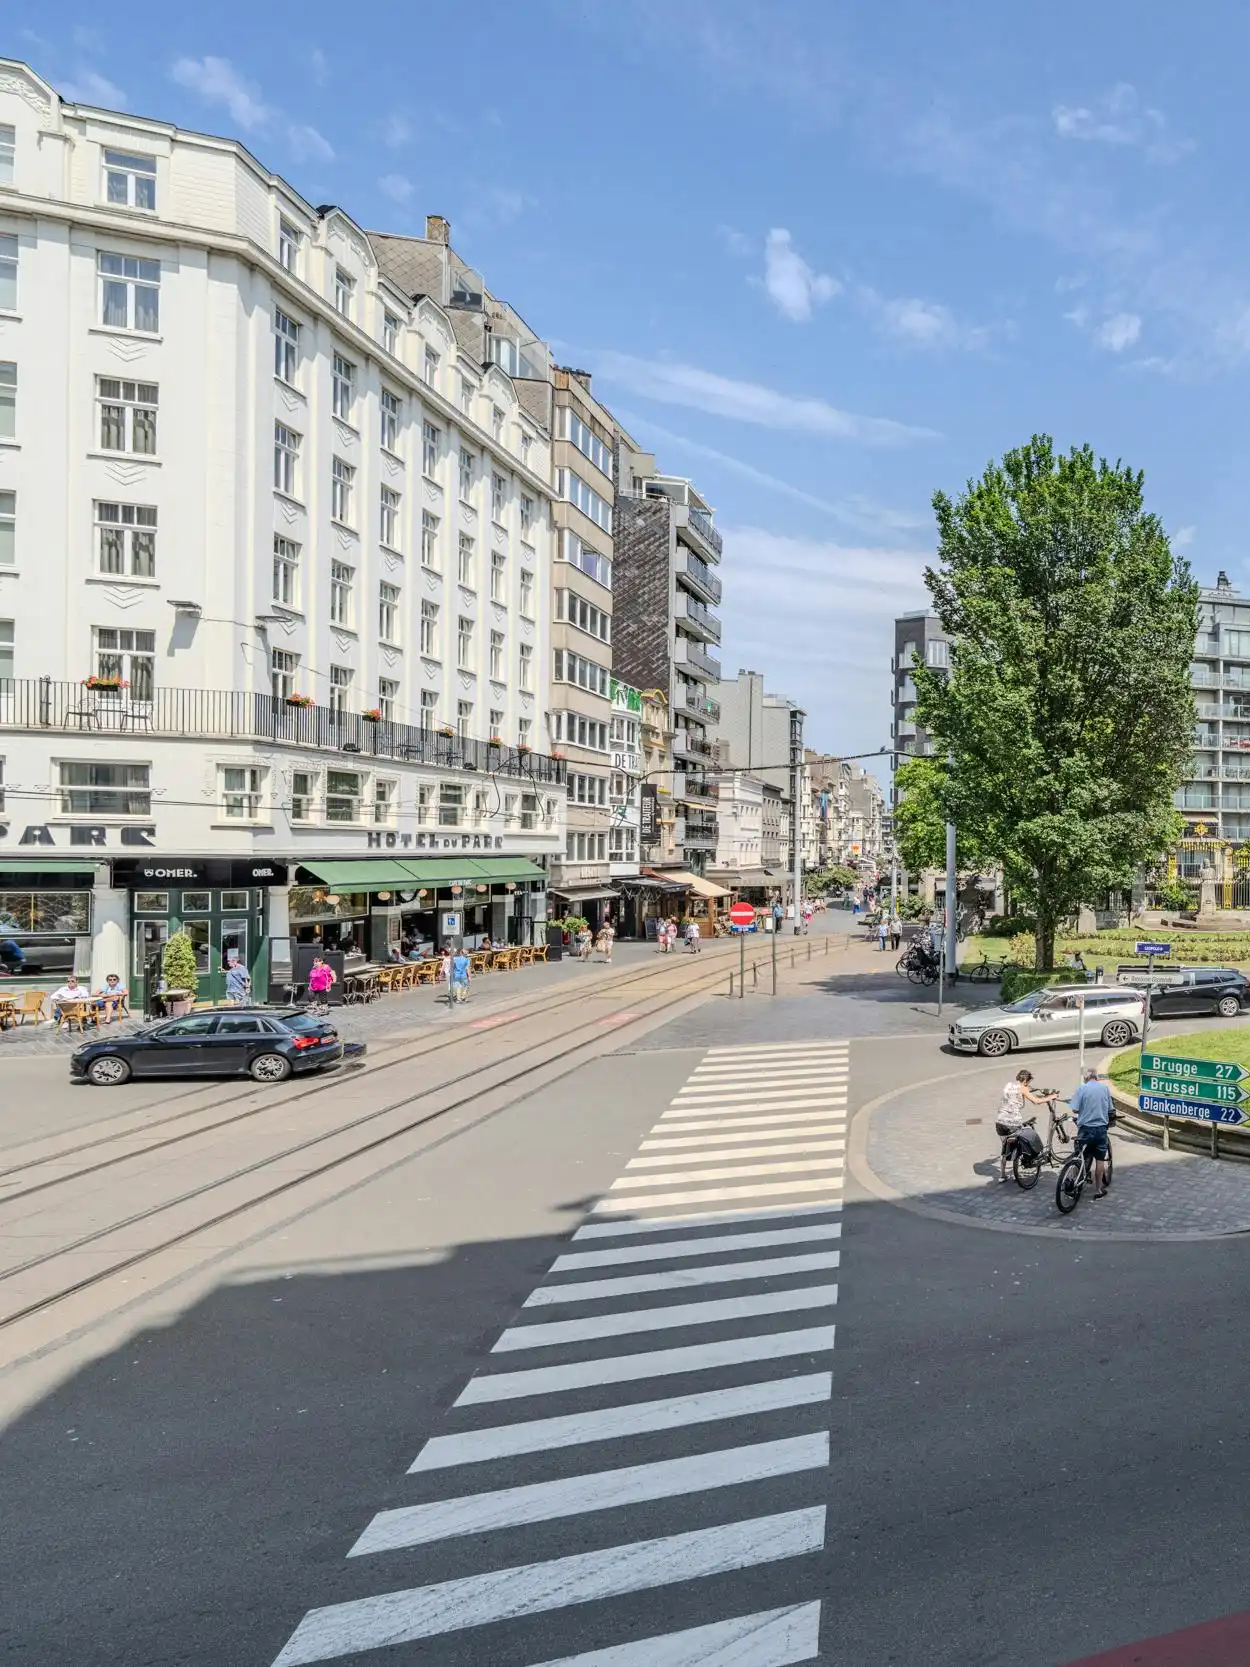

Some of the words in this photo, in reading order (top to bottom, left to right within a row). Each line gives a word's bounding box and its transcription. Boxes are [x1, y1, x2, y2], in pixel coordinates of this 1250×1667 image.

[642, 797, 651, 824] TRAITEUR
[0, 825, 156, 846] ARC
[642, 824, 651, 833] DE
[367, 832, 440, 848] HOTEL
[1152, 1057, 1198, 1077] Brugge
[1215, 1064, 1234, 1078] 27
[1150, 1077, 1199, 1096] Brussel
[1217, 1085, 1236, 1100] 115
[1143, 1096, 1210, 1120] Blankenberge
[1220, 1107, 1235, 1122] 22
